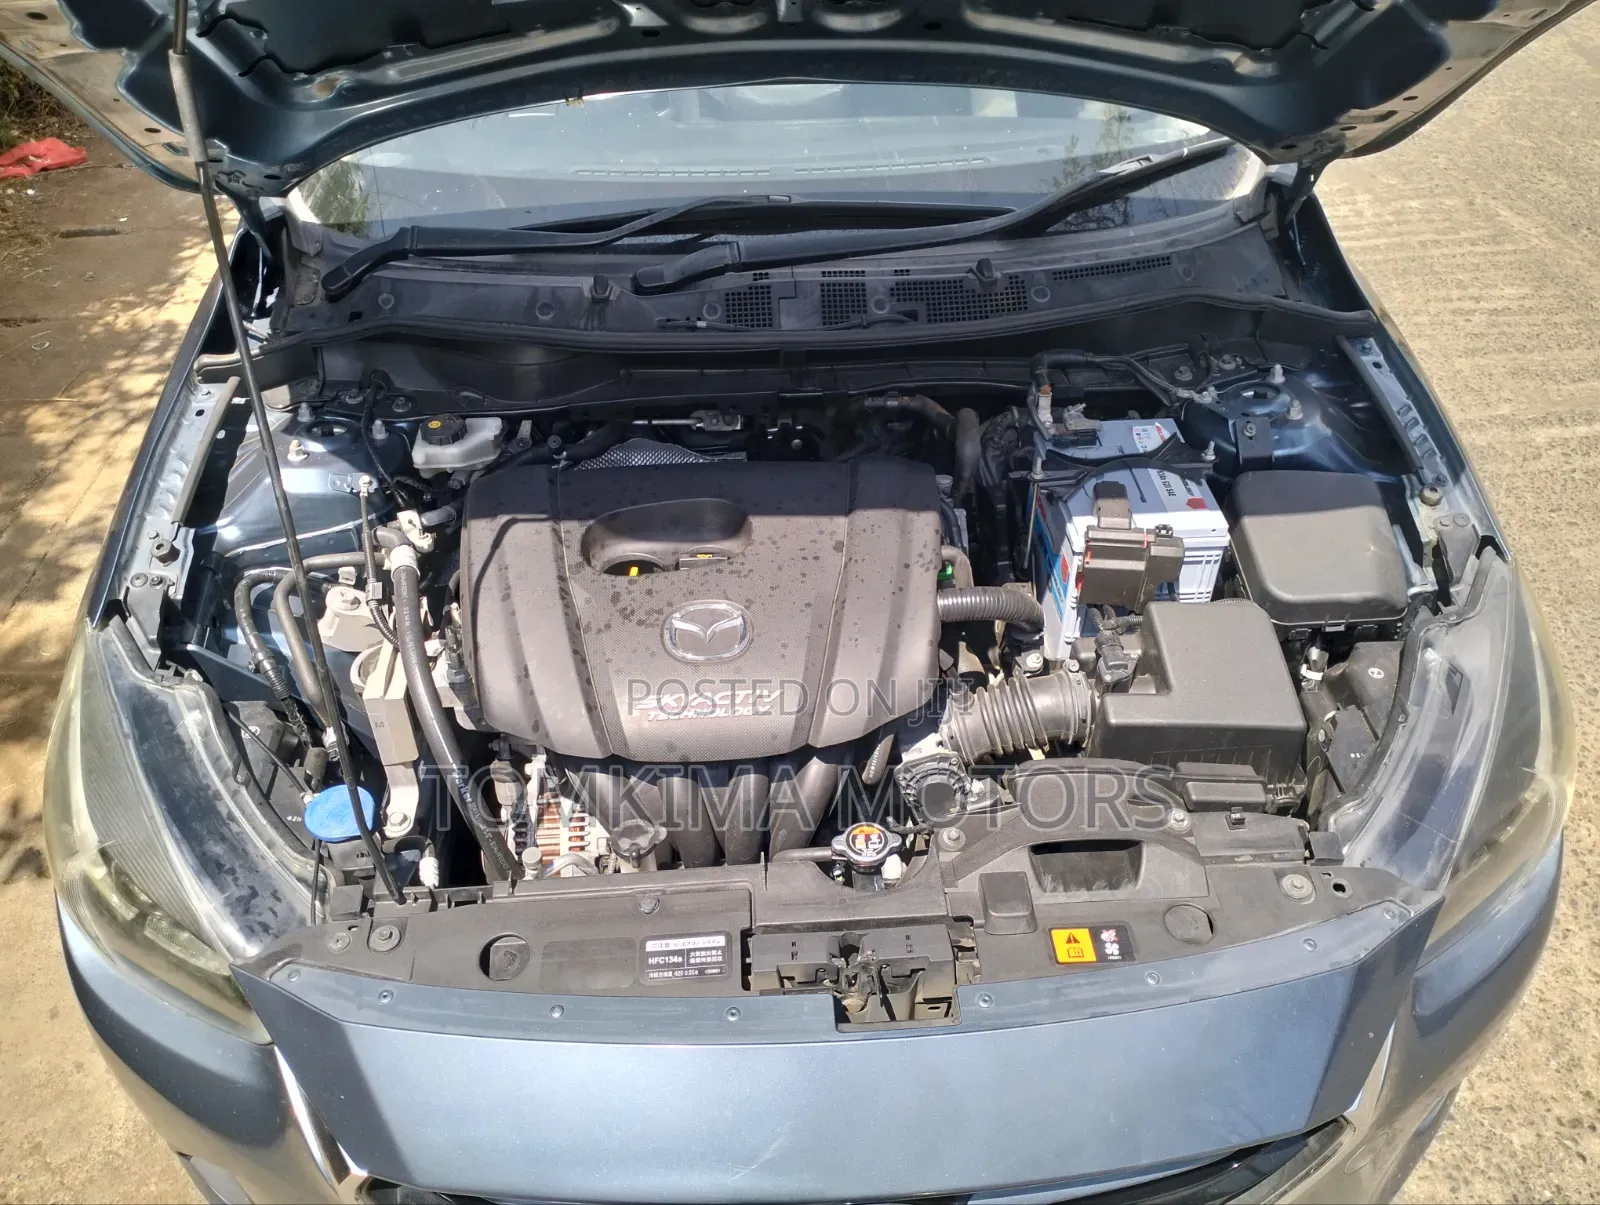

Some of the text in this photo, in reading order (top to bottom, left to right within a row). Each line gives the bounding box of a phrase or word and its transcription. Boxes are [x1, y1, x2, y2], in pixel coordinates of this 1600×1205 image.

[634, 689, 784, 710] SKYACTIV
[647, 705, 772, 722] TECHNOLOGY
[648, 955, 683, 965] HFC134a
